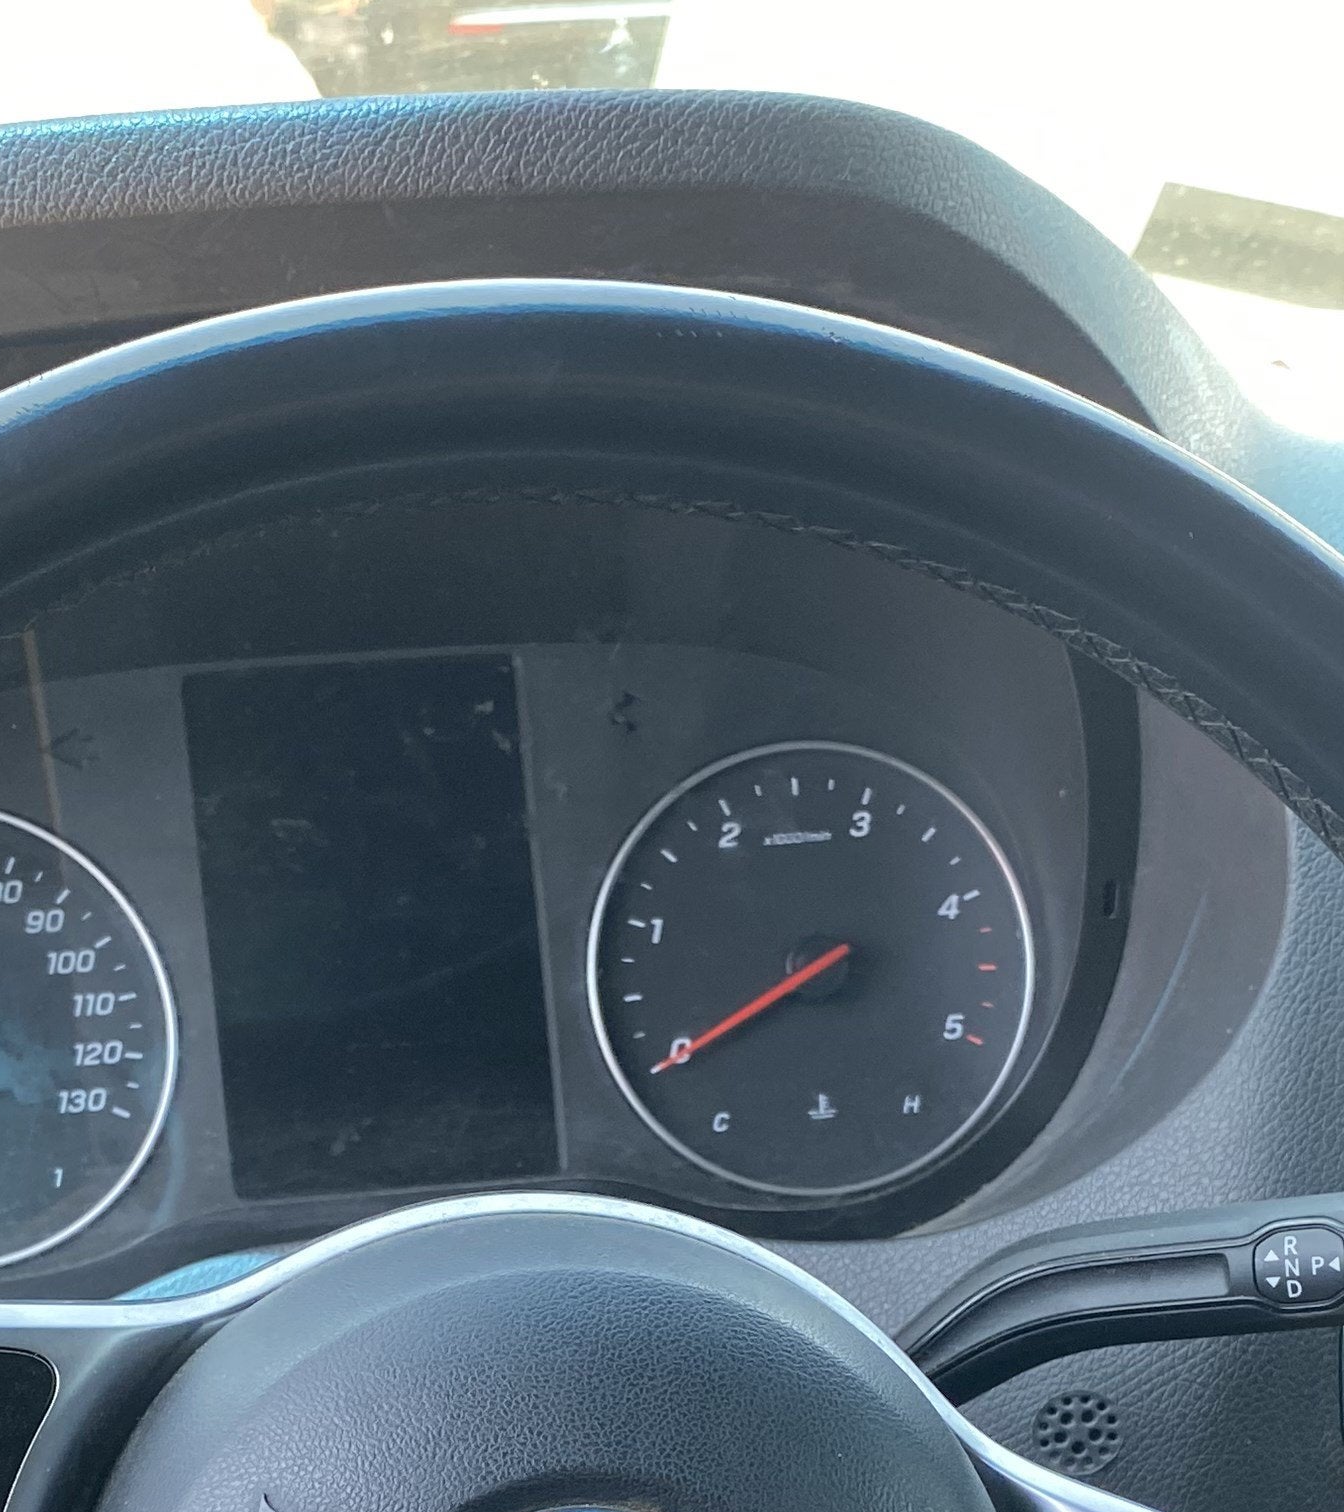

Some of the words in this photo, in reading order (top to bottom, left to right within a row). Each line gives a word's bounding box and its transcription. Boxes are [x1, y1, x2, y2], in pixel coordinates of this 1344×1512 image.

[718, 822, 742, 849] 2
[849, 811, 872, 838] 3
[937, 894, 960, 920] 4
[24, 910, 65, 933] 90
[650, 918, 665, 944] 1
[46, 950, 96, 974] 100
[72, 993, 115, 1017] 110
[942, 1013, 965, 1041] 5
[73, 1042, 122, 1066] 120
[57, 1089, 107, 1114] 130
[902, 1094, 922, 1115] H
[712, 1112, 731, 1133] C
[52, 1168, 64, 1188] 1
[1283, 1235, 1298, 1256] R
[1284, 1258, 1301, 1278] N
[1311, 1256, 1325, 1276] P
[1287, 1279, 1303, 1298] D
